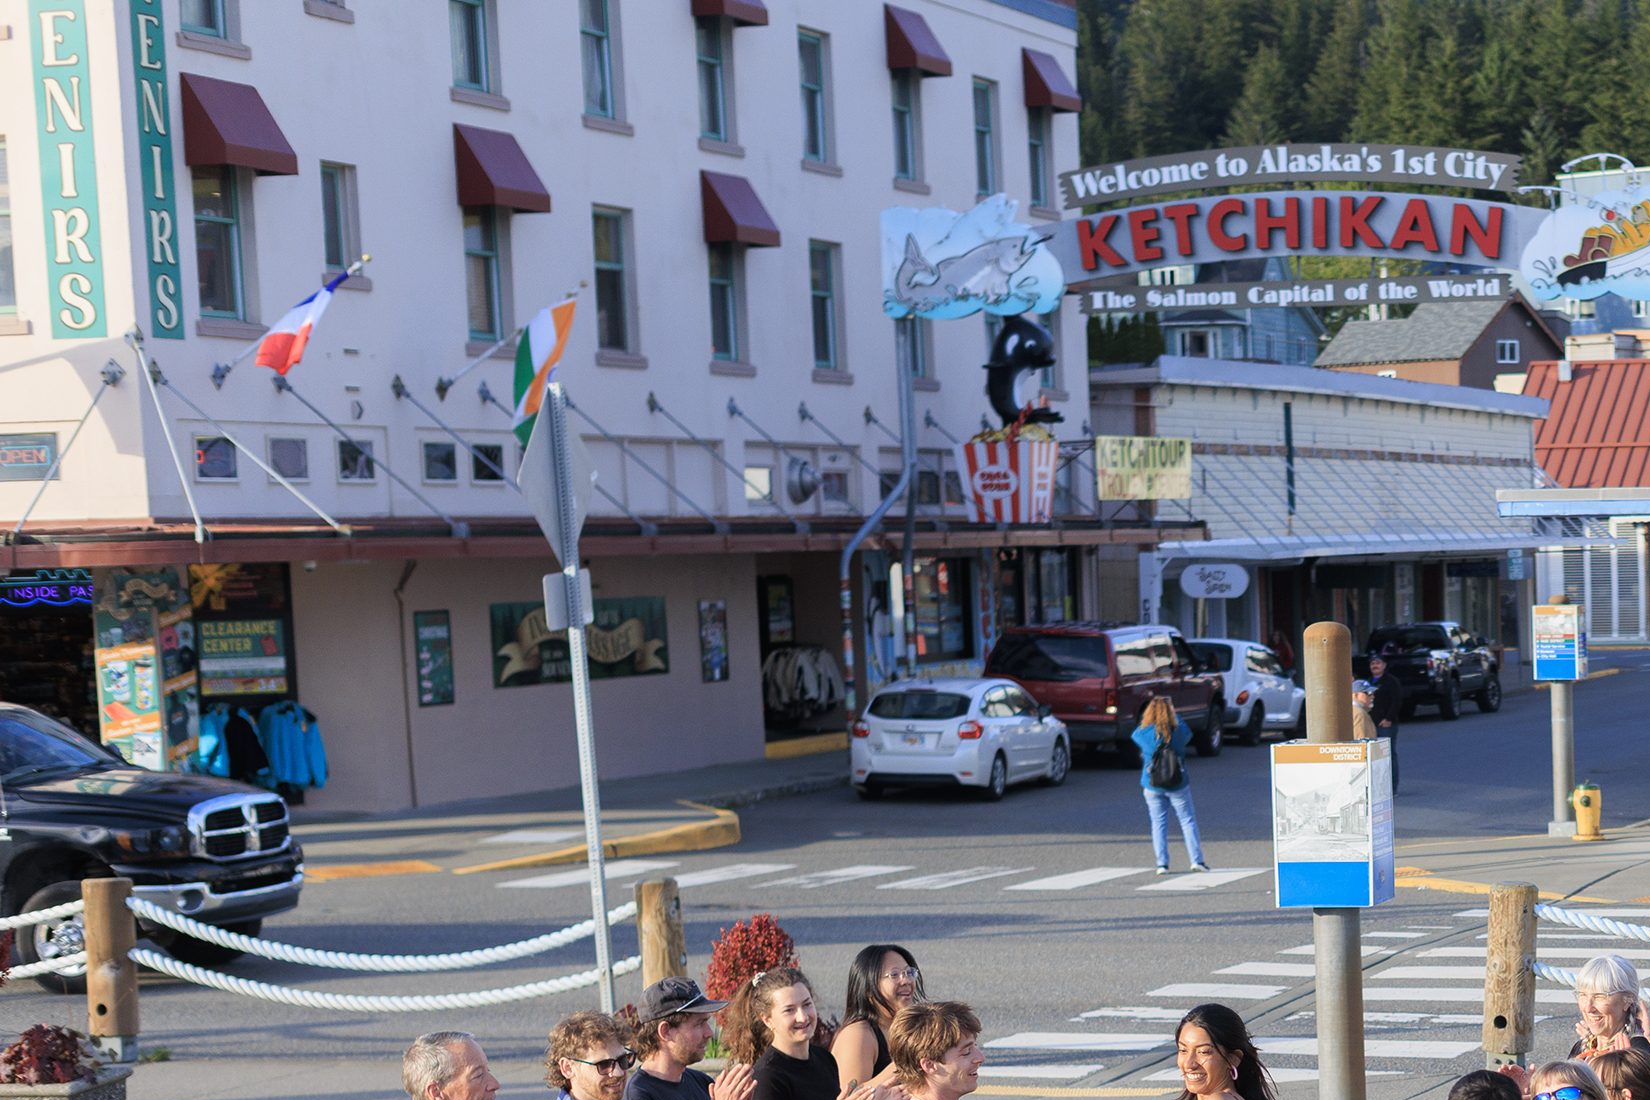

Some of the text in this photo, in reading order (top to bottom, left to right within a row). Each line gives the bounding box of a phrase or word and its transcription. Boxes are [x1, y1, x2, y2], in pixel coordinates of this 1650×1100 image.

[38, 0, 97, 330] ENIRS
[136, 0, 179, 331] ENIRS
[1070, 145, 1509, 198] Welcome to Alaska's 1st City
[1076, 196, 1504, 271] KETCHIKAN
[1088, 278, 1501, 310] The Salmon Capital of the World
[0, 449, 46, 464] OPEN
[7, 585, 60, 599] INSIDE
[201, 620, 278, 637] CLEARANCE
[202, 637, 253, 654] CENTER
[1319, 746, 1362, 755] DOWNTOWN
[1333, 753, 1362, 761] DISTRICT
